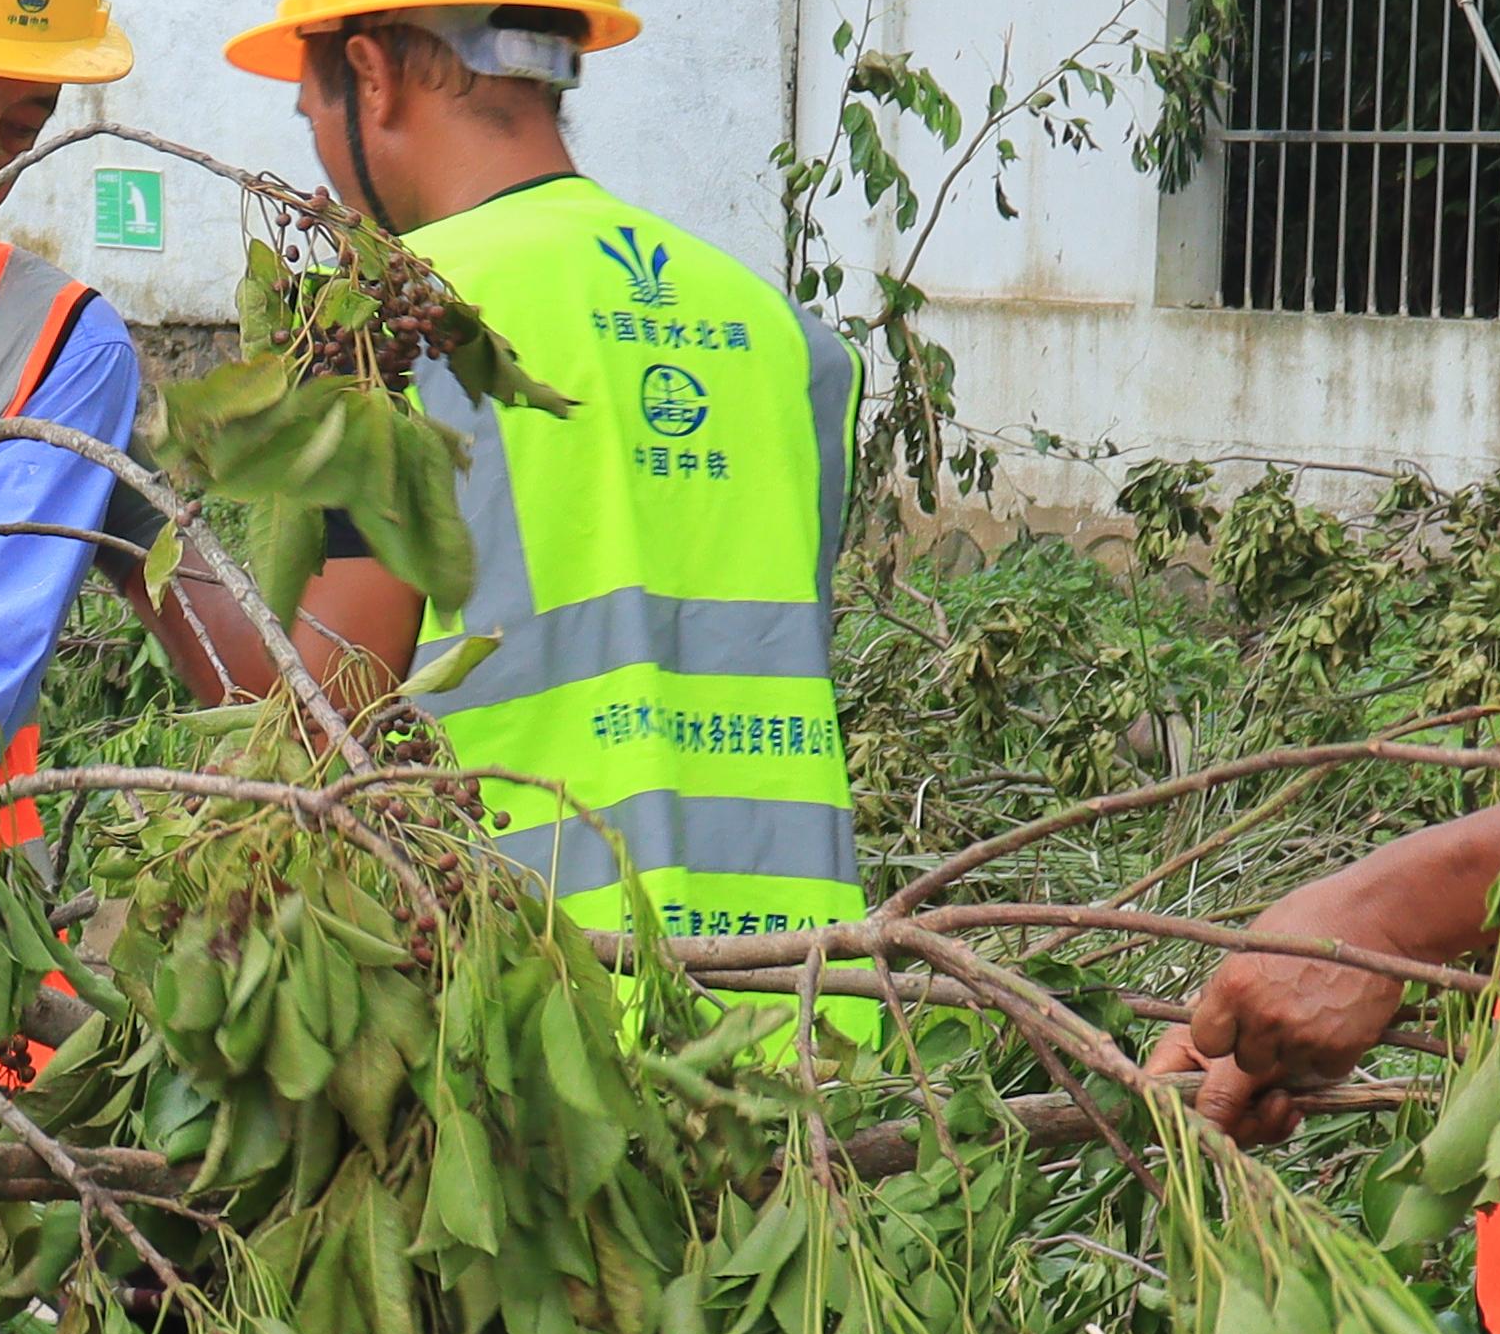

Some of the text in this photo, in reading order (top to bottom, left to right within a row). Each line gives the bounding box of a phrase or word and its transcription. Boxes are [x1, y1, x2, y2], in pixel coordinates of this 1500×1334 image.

[592, 308, 752, 352] 中国南水北调
[634, 443, 730, 480] 中国中铁
